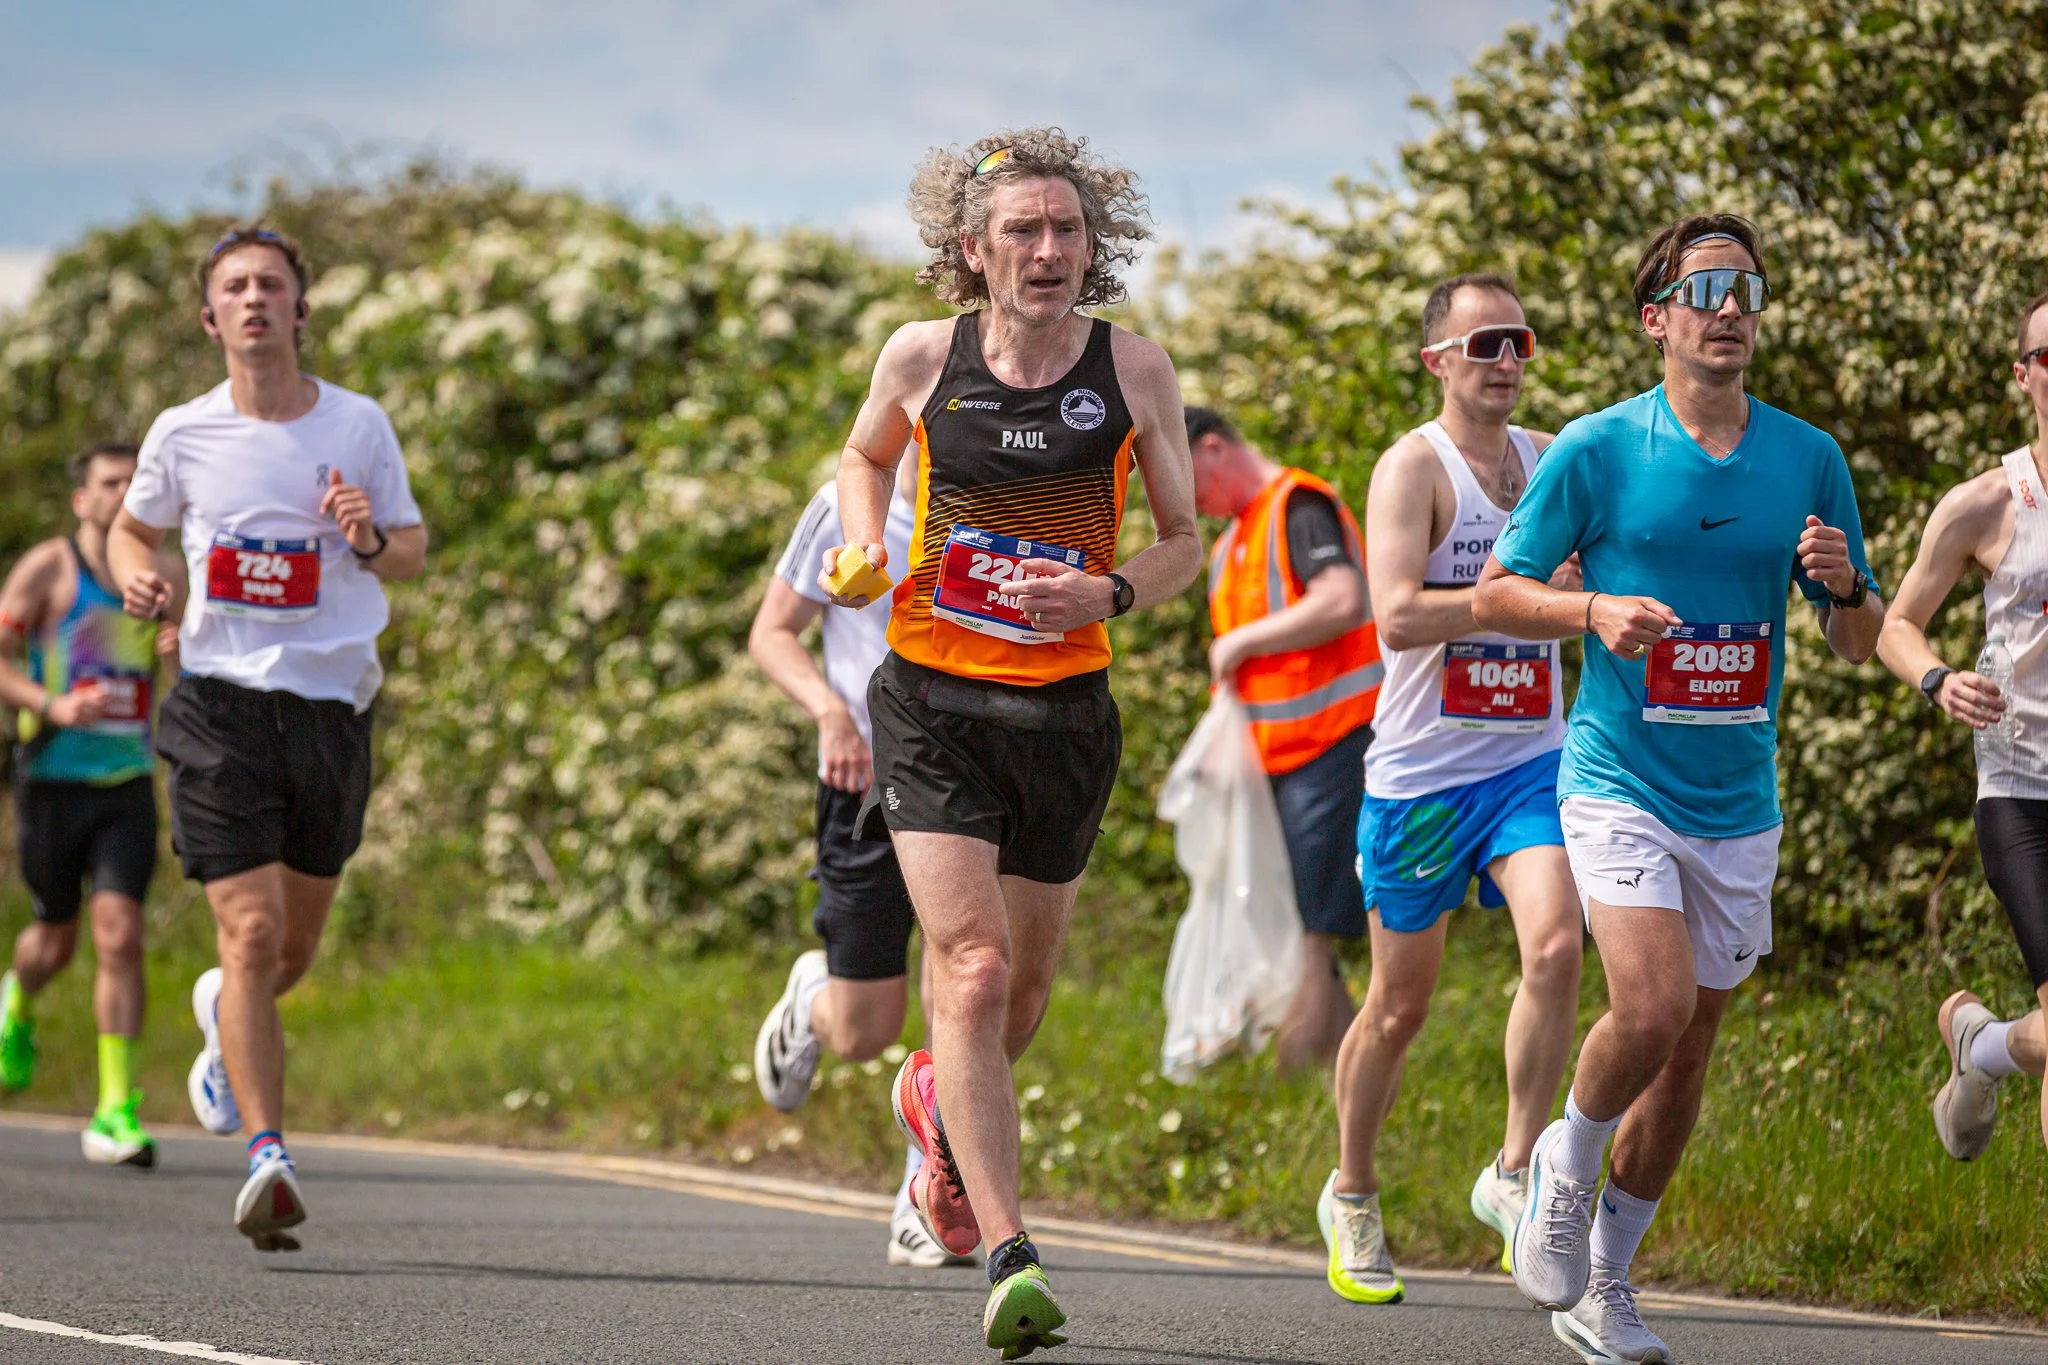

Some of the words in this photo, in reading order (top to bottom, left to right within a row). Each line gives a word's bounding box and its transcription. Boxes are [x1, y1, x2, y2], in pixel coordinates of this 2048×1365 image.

[959, 400, 1002, 410] INVERSE
[1063, 391, 1076, 407] BRAY
[1077, 389, 1104, 410] RUNNERS
[1062, 408, 1086, 429] ATHLETIC
[1092, 412, 1104, 427] CLUB
[1002, 430, 1048, 449] PAUL
[2018, 479, 2038, 510] soar
[1453, 538, 1498, 556] POR
[236, 551, 293, 580] 724
[1453, 563, 1484, 578] RU
[987, 589, 1024, 610] PAU
[1672, 643, 1756, 673] 2083
[1467, 661, 1536, 689] 1064
[1689, 679, 1741, 694] ELIOTT
[1491, 693, 1515, 706] ALI
